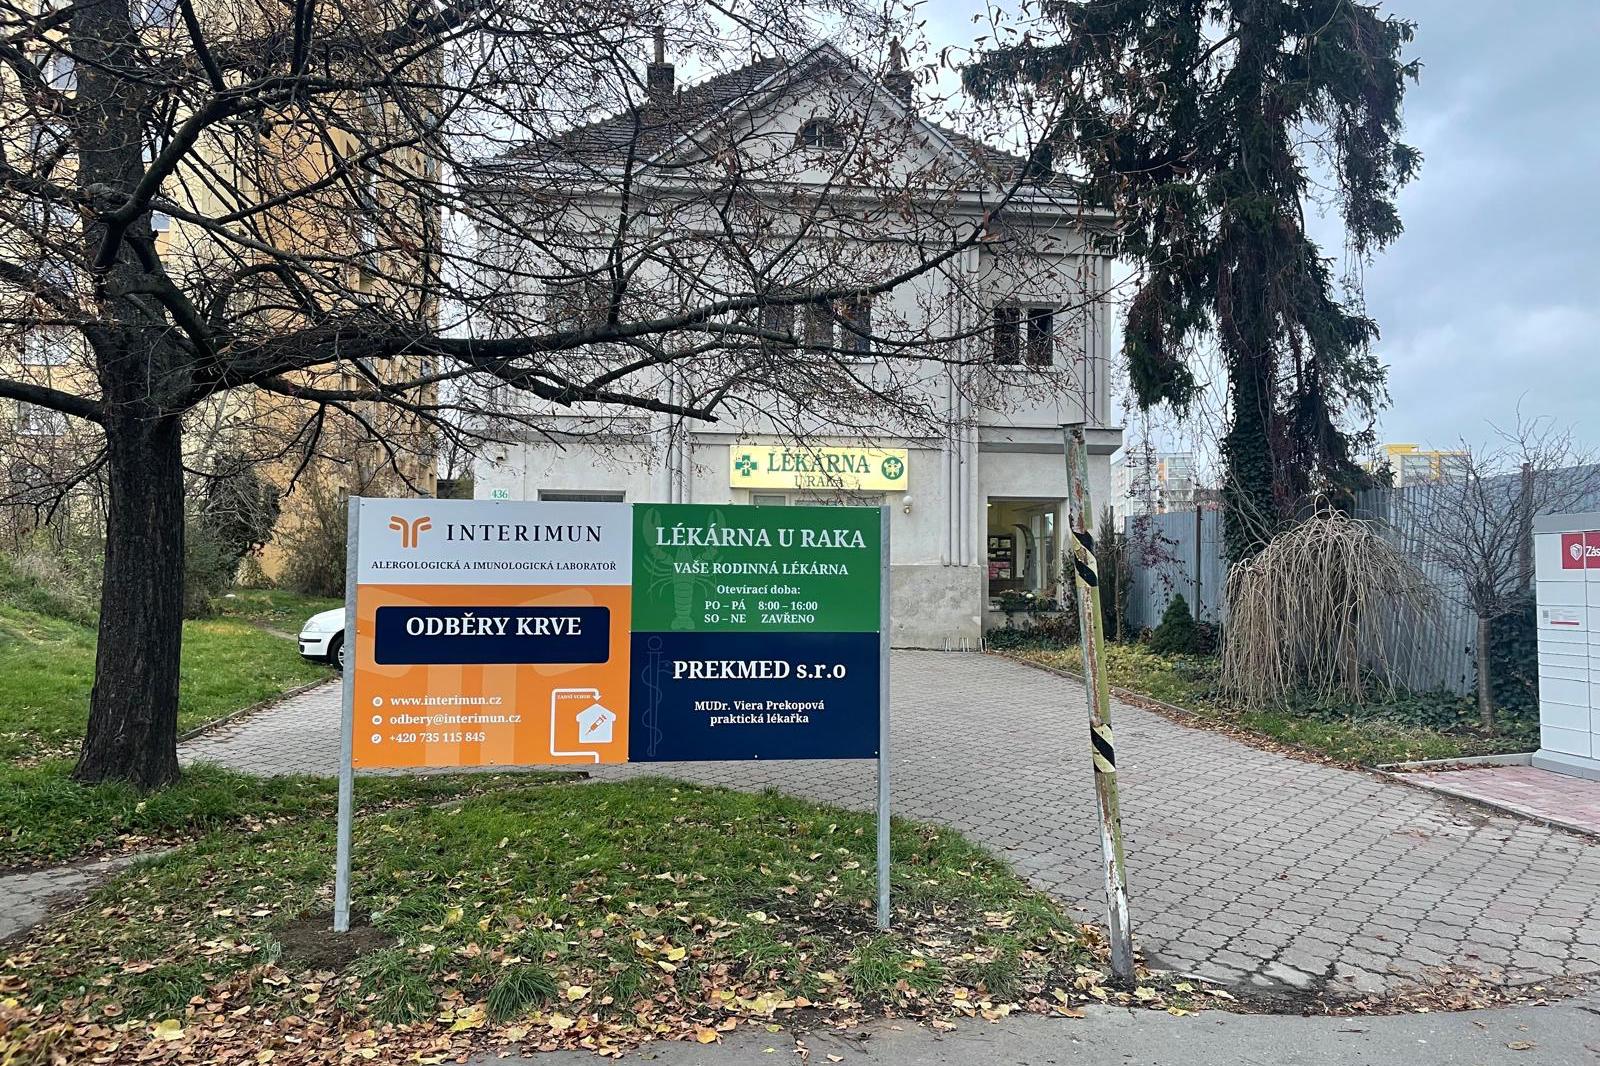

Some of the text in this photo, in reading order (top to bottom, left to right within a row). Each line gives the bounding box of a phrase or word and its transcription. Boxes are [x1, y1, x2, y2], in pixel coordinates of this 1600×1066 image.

[768, 448, 870, 473] LÉKÁRNA
[794, 475, 844, 488] U RAKA
[492, 489, 508, 498] 436
[447, 524, 602, 542] INTERIMUN
[656, 522, 866, 548] LÉKÁRNA U RAKA
[372, 560, 617, 571] ALERGOLOGICKÁ A IMUNOLOGICKÁ LABORATOŘ
[674, 560, 848, 576] VAŠE RODINNÁ LÉKÁRNA
[716, 584, 800, 594] Otevírací doba:
[704, 600, 720, 610] PO
[732, 598, 746, 610] PÁ
[758, 600, 780, 610] 8:00
[791, 600, 818, 610] 16:00
[406, 612, 582, 636] ODBĚRY KRVE
[704, 614, 720, 623] SO
[731, 614, 746, 623] NE
[761, 612, 814, 624] ZAVŘENO
[672, 660, 846, 680] PREKMED s.r.o
[390, 695, 502, 706] www.interimun.cz
[694, 700, 824, 712] MUDr. Viera Prekopová
[390, 713, 522, 726] odbery@interimun.cz
[710, 714, 809, 726] praktická lékařka
[390, 732, 486, 742] +420 735 115 845
